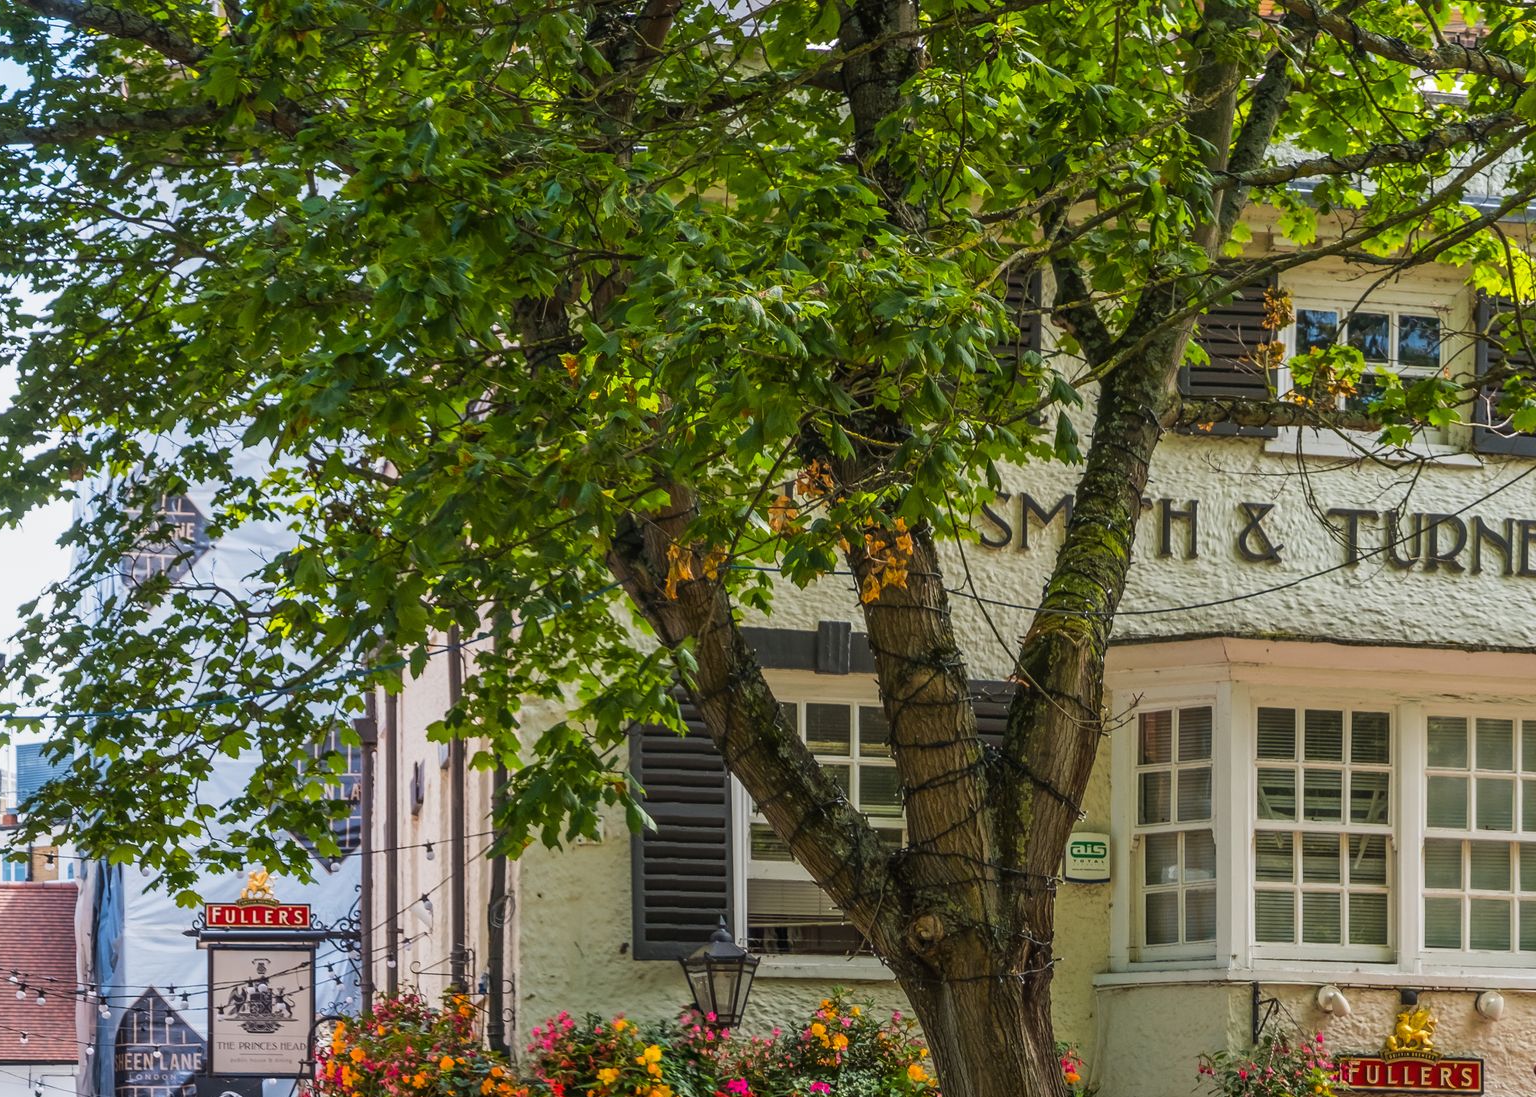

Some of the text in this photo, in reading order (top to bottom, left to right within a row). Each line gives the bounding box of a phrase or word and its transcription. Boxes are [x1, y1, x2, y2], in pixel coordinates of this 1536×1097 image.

[978, 490, 1199, 560] SMH
[1237, 502, 1285, 563] &
[212, 907, 303, 925] FULLER'S
[217, 1041, 306, 1050] THE PRINCES HEAD
[115, 1052, 203, 1072] SHEEN LANE
[1347, 1063, 1473, 1090] FULLER'S
